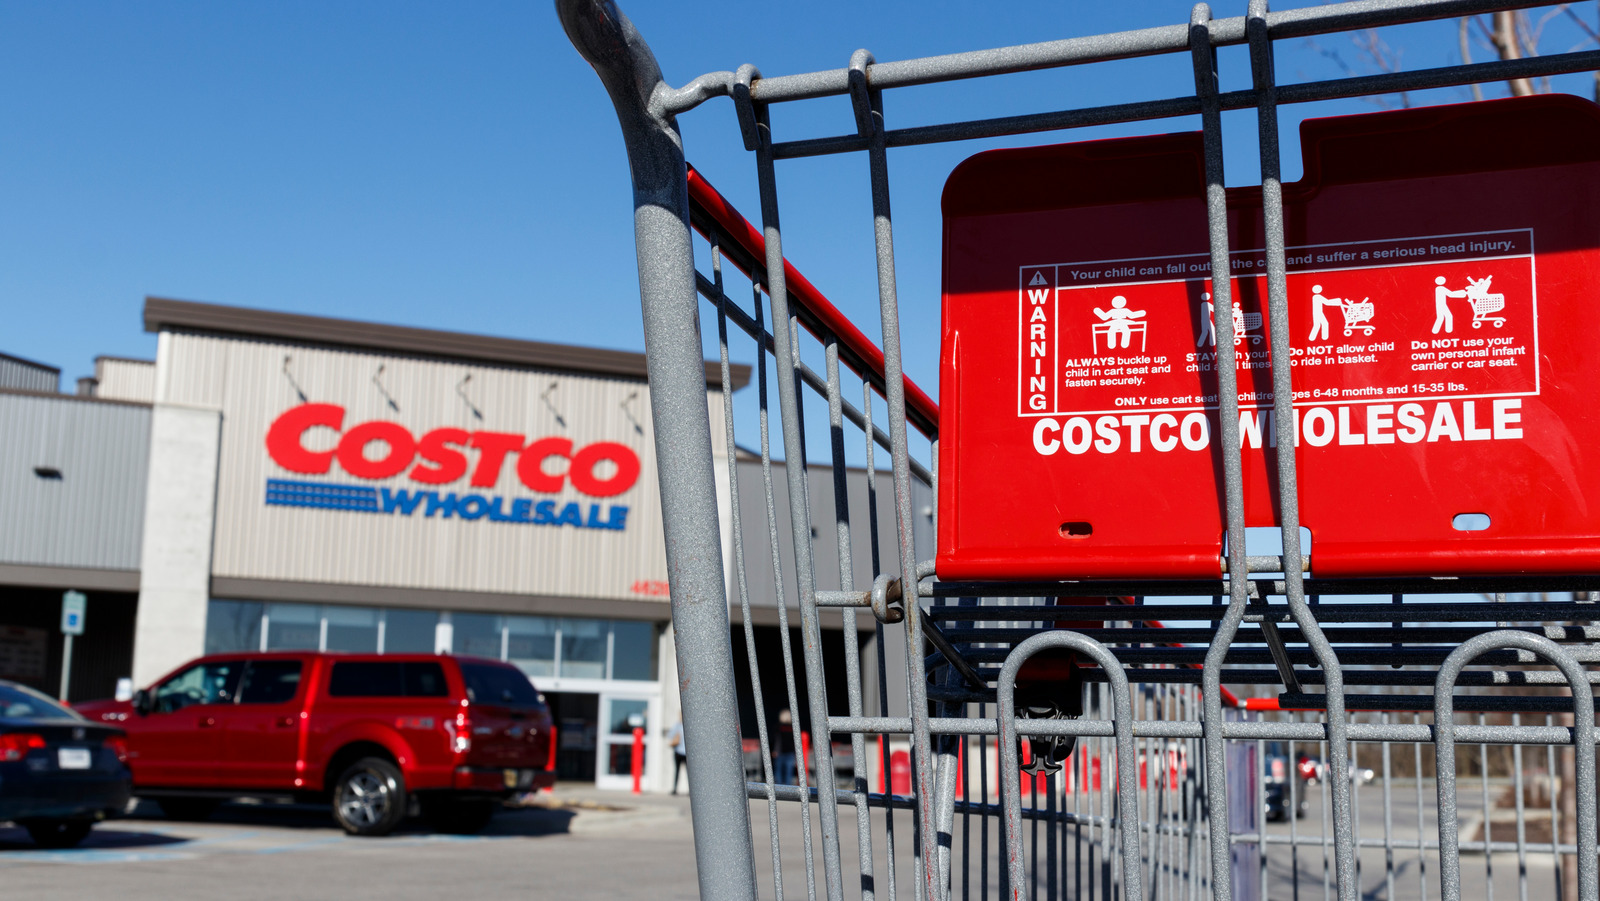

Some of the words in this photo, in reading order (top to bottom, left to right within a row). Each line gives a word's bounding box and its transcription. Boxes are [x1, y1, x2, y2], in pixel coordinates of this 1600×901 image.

[1071, 269, 1101, 281] Your
[1104, 266, 1136, 278] child
[1139, 266, 1163, 276] can
[1166, 263, 1187, 274] fall
[1190, 261, 1212, 272] out
[1232, 259, 1253, 269] the
[1287, 254, 1312, 265] and
[1317, 251, 1356, 263] suffer
[1361, 252, 1369, 260] a
[1373, 246, 1426, 259] serious
[1430, 242, 1466, 254] head
[1470, 240, 1515, 254] injury.
[1028, 289, 1049, 410] WARNING
[1307, 346, 1333, 355] NOT
[1337, 344, 1366, 354] allow
[1368, 341, 1394, 352] child
[1411, 340, 1428, 350] Do
[1432, 338, 1460, 349] NOT
[1462, 339, 1484, 347] use
[1487, 337, 1514, 349] your
[1186, 353, 1217, 362] STAY
[1245, 351, 1269, 362] your
[1301, 355, 1322, 366] ride
[1325, 355, 1335, 364] in
[1338, 353, 1378, 364] basket.
[1411, 352, 1435, 361] own
[1439, 347, 1489, 361] personal
[1492, 345, 1525, 357] infant
[1066, 356, 1115, 367] ALWAYS
[1117, 354, 1150, 365] buckle
[1153, 355, 1167, 366] up
[1186, 363, 1210, 372] child
[1242, 360, 1271, 369] times
[1411, 360, 1449, 371] carrier
[1452, 360, 1465, 369] or
[1467, 359, 1486, 368] car
[1488, 357, 1517, 368] seat.
[1065, 367, 1089, 377] child
[1092, 366, 1101, 376] in
[1103, 365, 1124, 375] cart
[1127, 365, 1148, 374] seat
[1151, 363, 1171, 373] and
[1065, 377, 1096, 387] fasten
[1099, 375, 1146, 387] securely.
[1114, 396, 1147, 407] ONLY
[1150, 397, 1169, 405] use
[1172, 395, 1192, 404] cart
[1195, 394, 1218, 403] seat
[1238, 391, 1273, 401] childre
[1291, 389, 1311, 400] ges
[1313, 387, 1339, 397] 6-48
[1342, 386, 1383, 396] months
[1386, 384, 1408, 394] and
[1412, 383, 1445, 394] 15-35
[1448, 381, 1468, 392] lbs.
[1032, 412, 1211, 456] COSTCO
[265, 402, 641, 498] COSTCO
[378, 486, 630, 530] WHOLESALE
